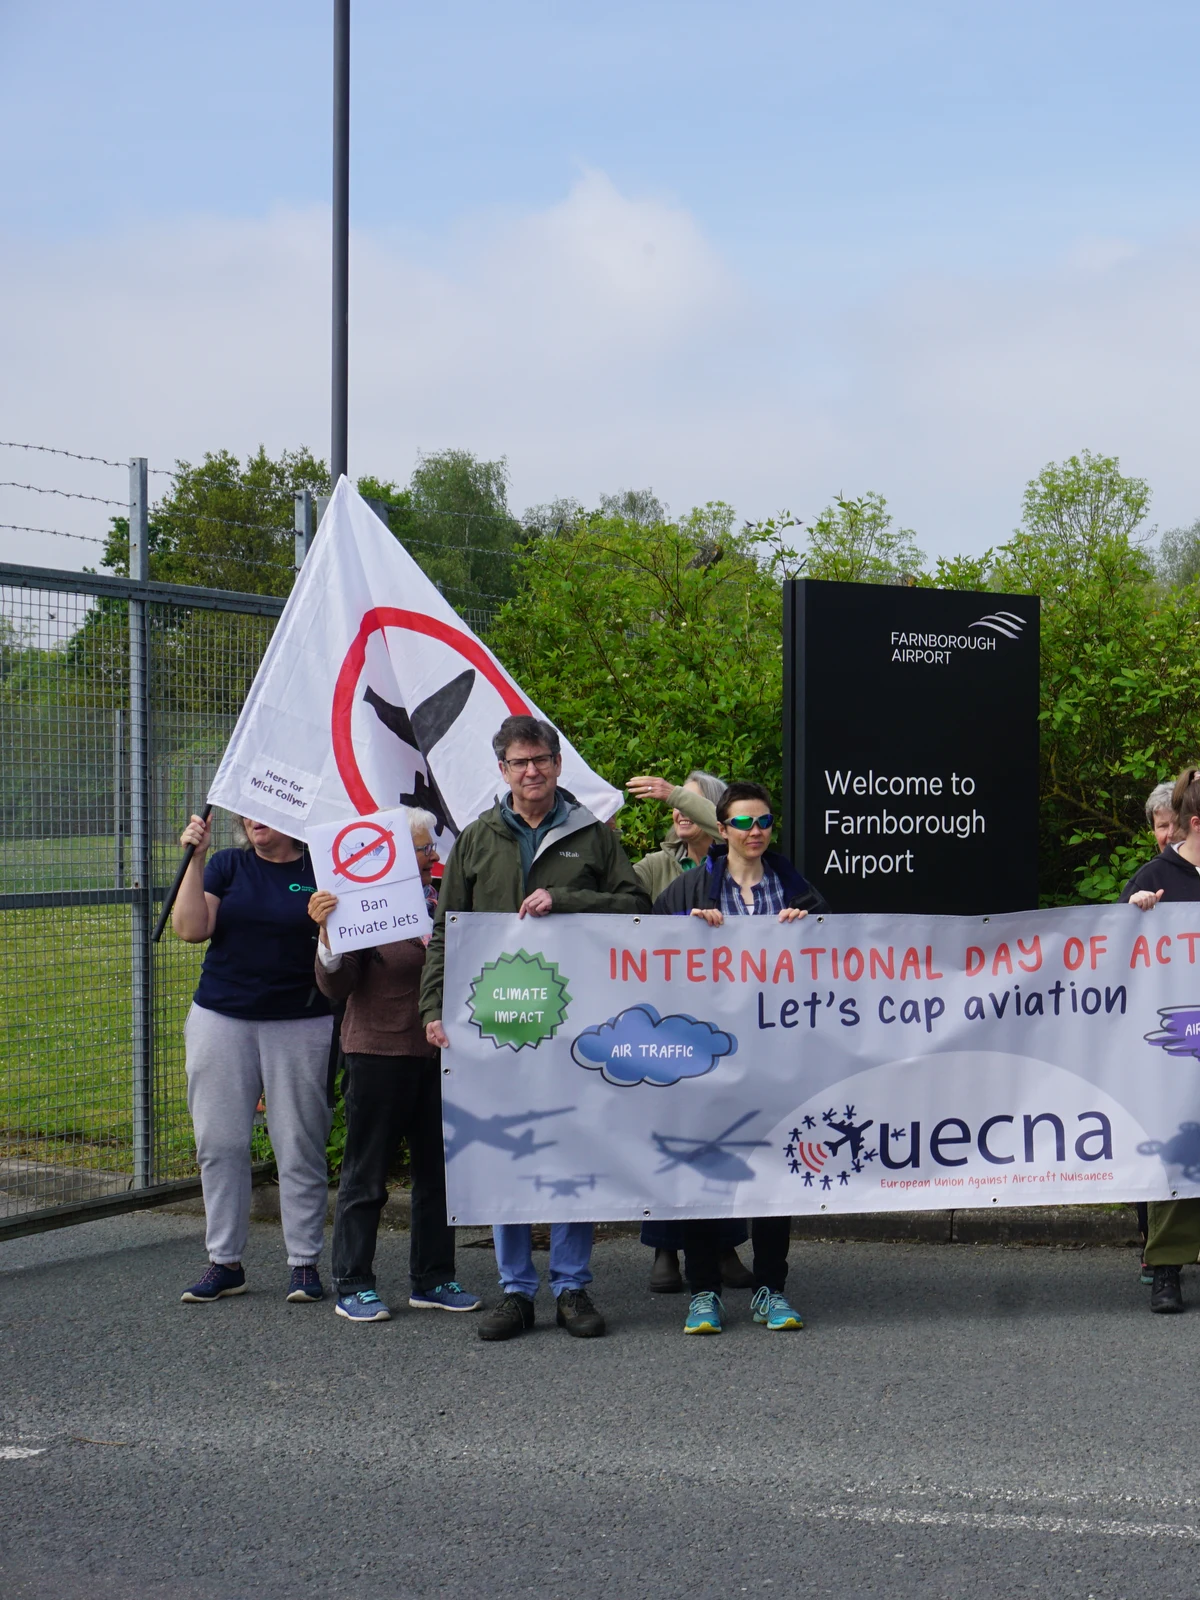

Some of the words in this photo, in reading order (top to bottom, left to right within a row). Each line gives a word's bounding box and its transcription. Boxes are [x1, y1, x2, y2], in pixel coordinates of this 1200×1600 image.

[890, 631, 996, 651] FARNBOROUGH
[891, 648, 952, 664] AIRPORT
[250, 777, 274, 794] Mick
[275, 788, 308, 809] Collyer
[265, 769, 288, 786] Here
[289, 780, 304, 793] for
[824, 769, 943, 796] Welcome
[951, 772, 976, 796] to
[824, 809, 986, 839] Farnborough
[824, 848, 914, 878] Airport
[360, 898, 388, 912] Ban
[338, 920, 388, 939] Private
[392, 913, 419, 929] Jets
[609, 945, 943, 984] INTERNATIONAL
[965, 935, 1043, 978] DAY
[1063, 935, 1108, 971] OF
[492, 986, 548, 1002] CLIMATE
[757, 990, 861, 1030] Let's
[878, 994, 946, 1033] cap
[964, 980, 1127, 1021] aviation
[494, 1009, 545, 1024] IMPACT
[610, 1043, 634, 1058] AIR
[638, 1043, 694, 1058] TRAFFIC
[879, 1110, 1114, 1170] uecna
[880, 1177, 931, 1191] European
[934, 1177, 964, 1188] Union
[968, 1175, 1008, 1189] Against
[1012, 1171, 1056, 1183] Aircraft
[1060, 1171, 1114, 1182] Nuisances
